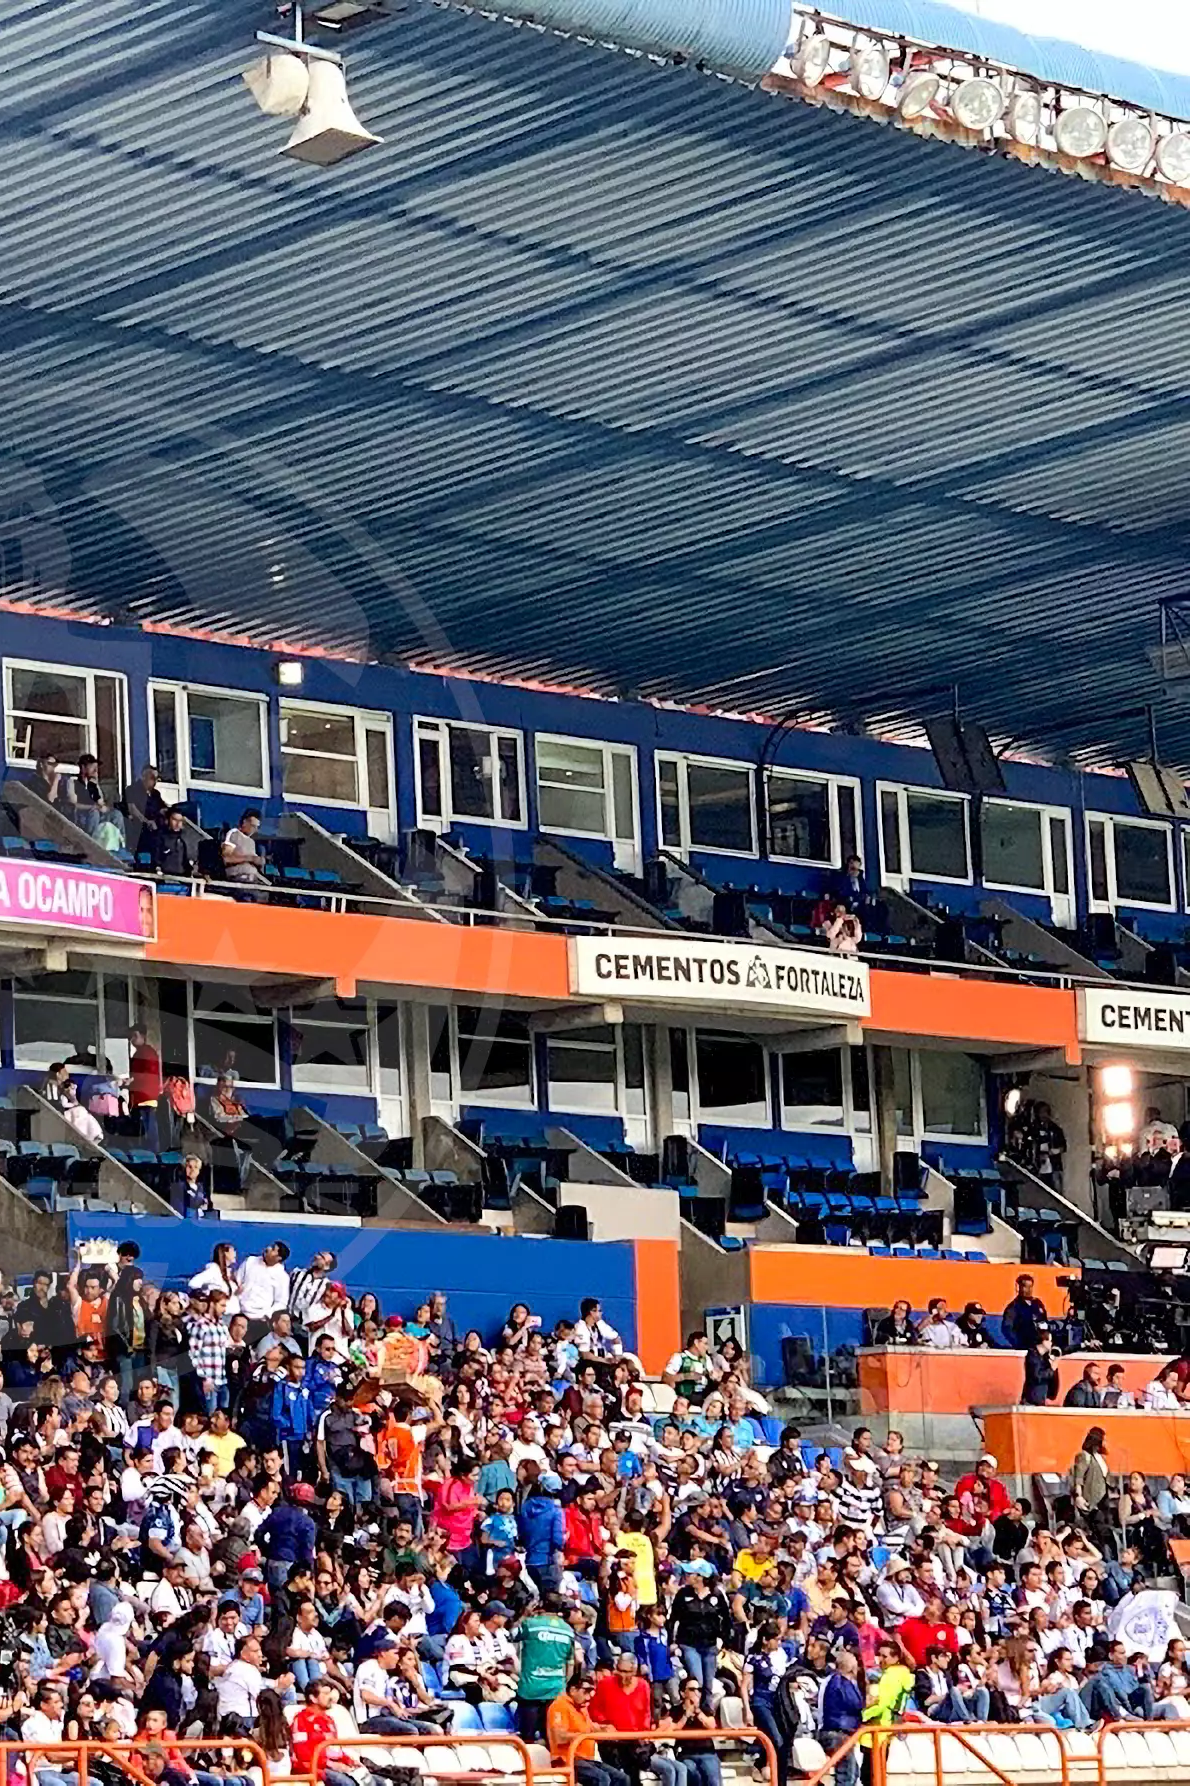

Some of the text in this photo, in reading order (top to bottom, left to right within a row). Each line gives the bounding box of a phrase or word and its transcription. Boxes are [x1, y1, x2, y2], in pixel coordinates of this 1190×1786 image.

[17, 871, 114, 922] OCAMPO
[595, 953, 865, 1003] CEMENTOS FORTALEZA
